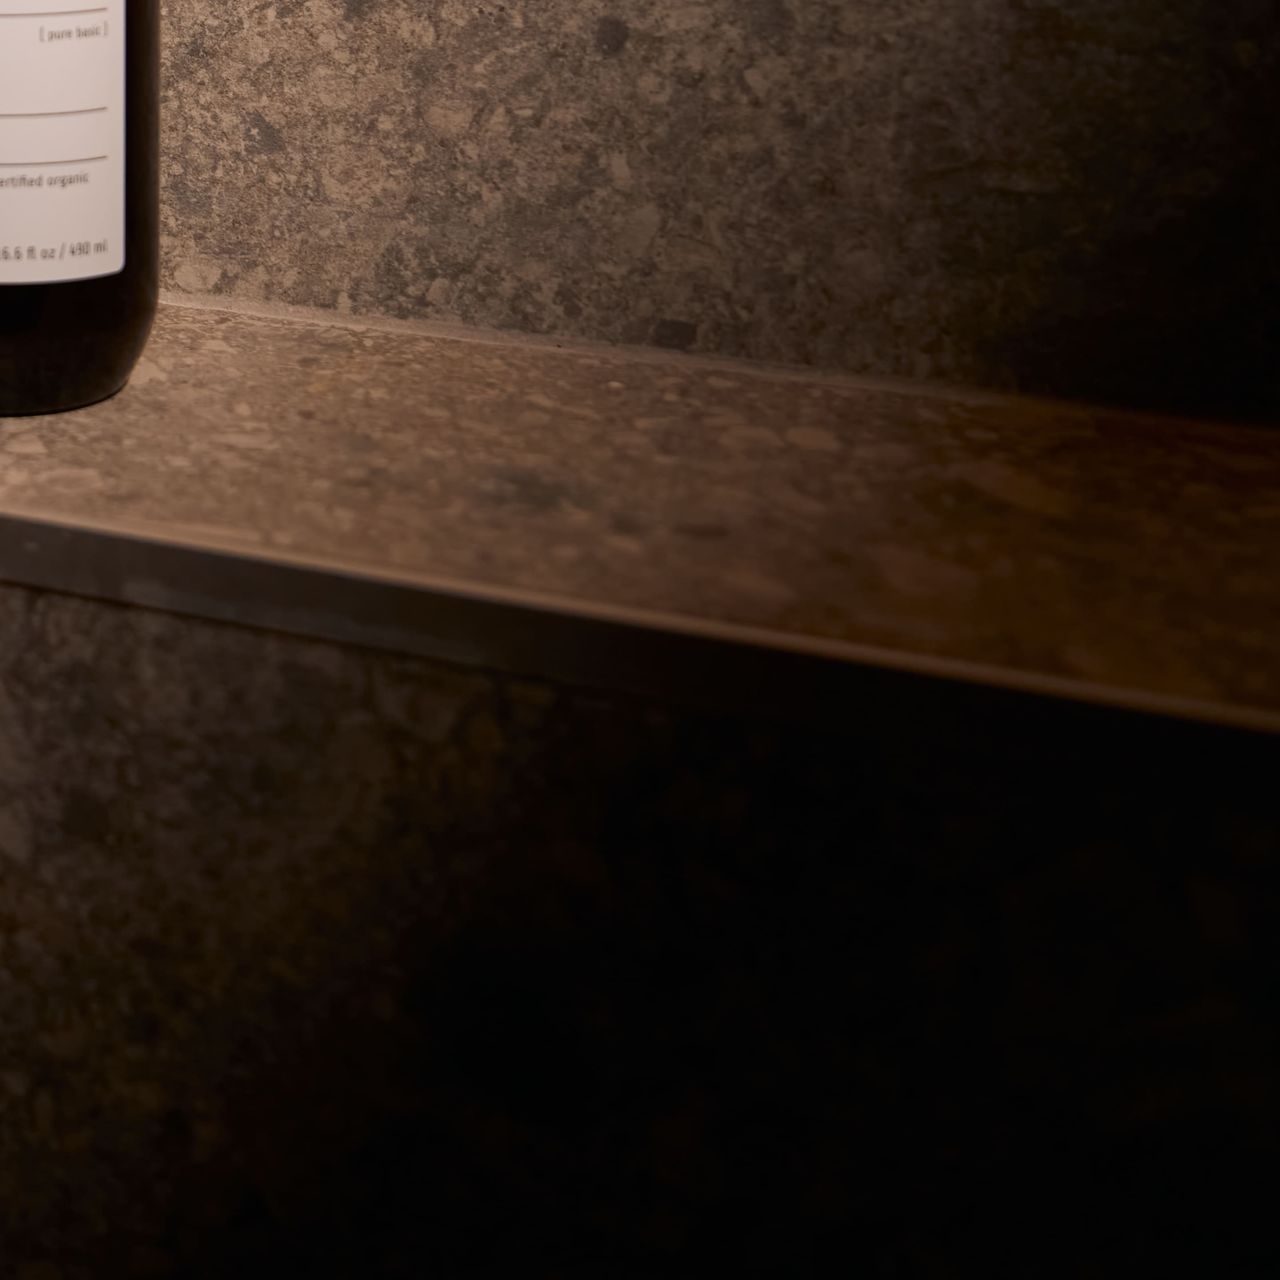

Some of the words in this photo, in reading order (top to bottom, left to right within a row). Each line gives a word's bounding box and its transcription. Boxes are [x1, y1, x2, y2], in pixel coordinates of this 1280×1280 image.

[48, 29, 72, 42] pure
[46, 172, 89, 188] organic
[40, 247, 56, 259] oz
[93, 238, 108, 254] ml
